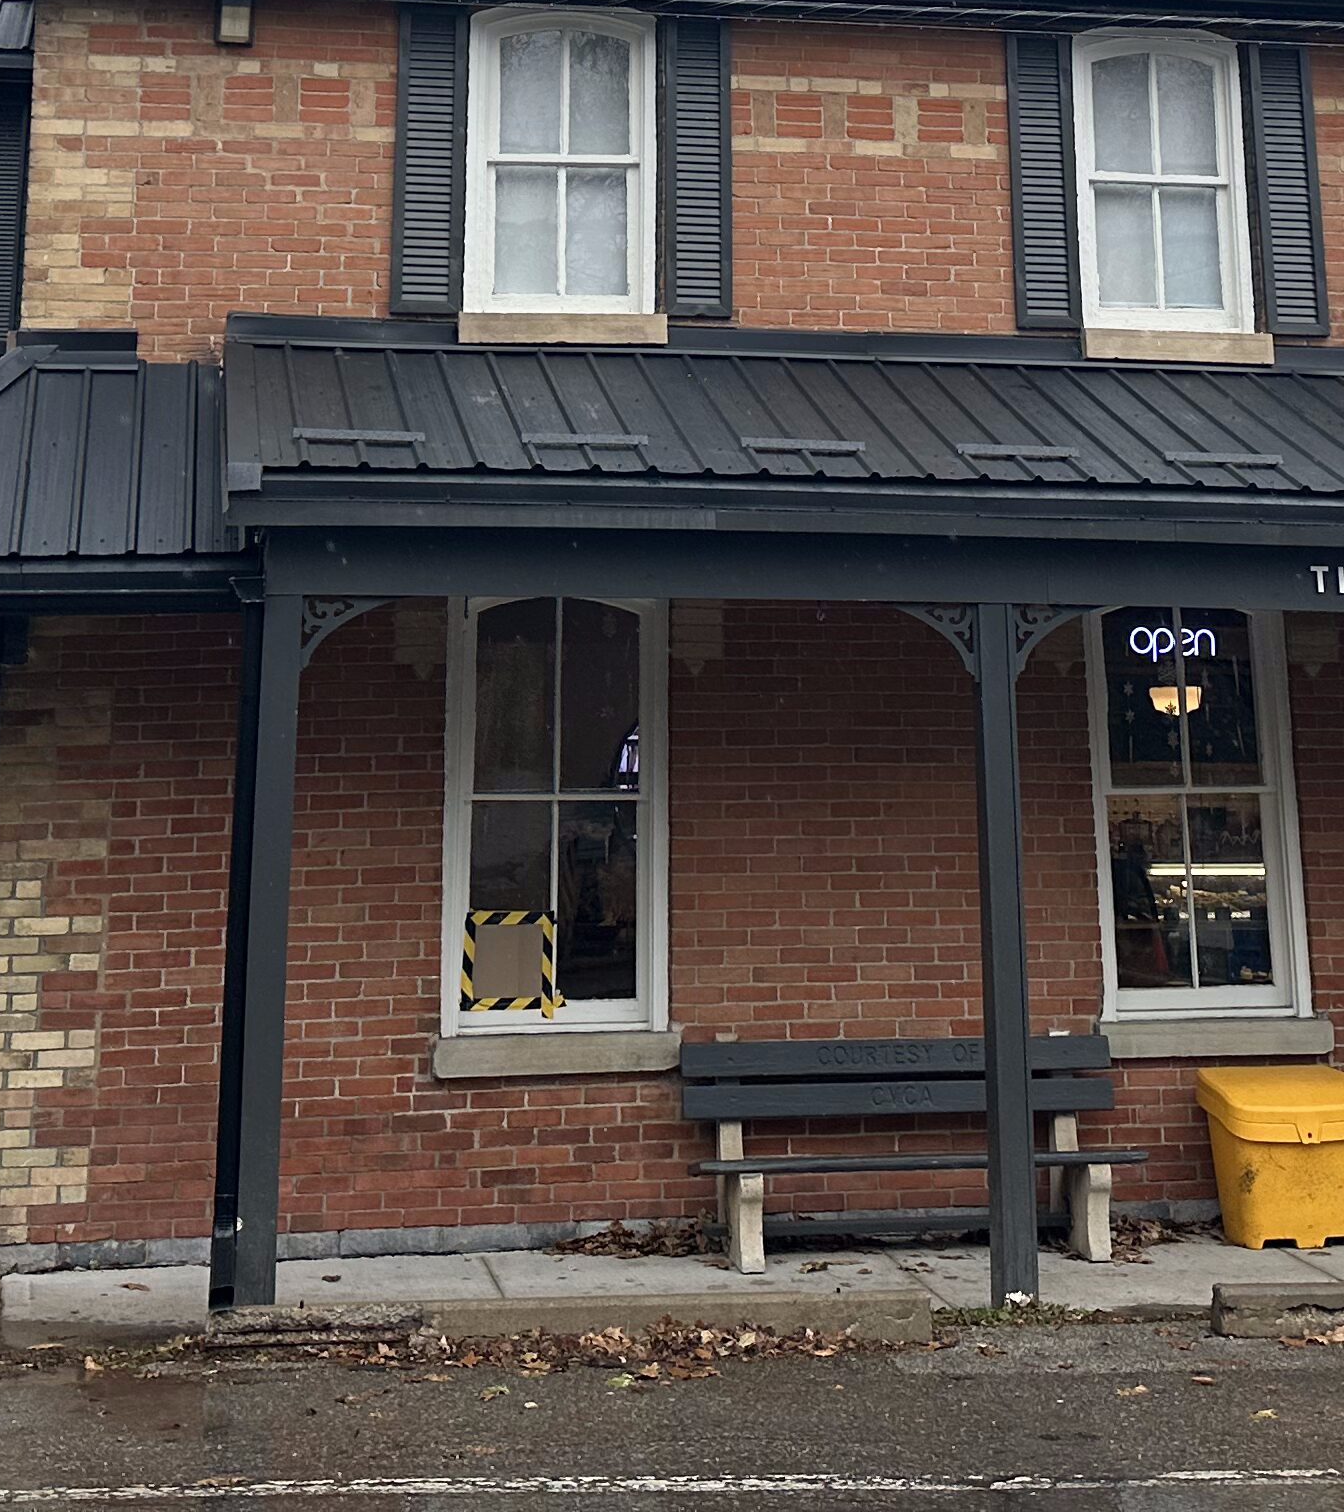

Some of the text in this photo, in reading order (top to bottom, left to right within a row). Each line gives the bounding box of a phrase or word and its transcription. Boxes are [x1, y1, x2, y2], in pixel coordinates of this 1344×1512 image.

[1129, 626, 1216, 663] open
[816, 1043, 980, 1066] COURTESY OF
